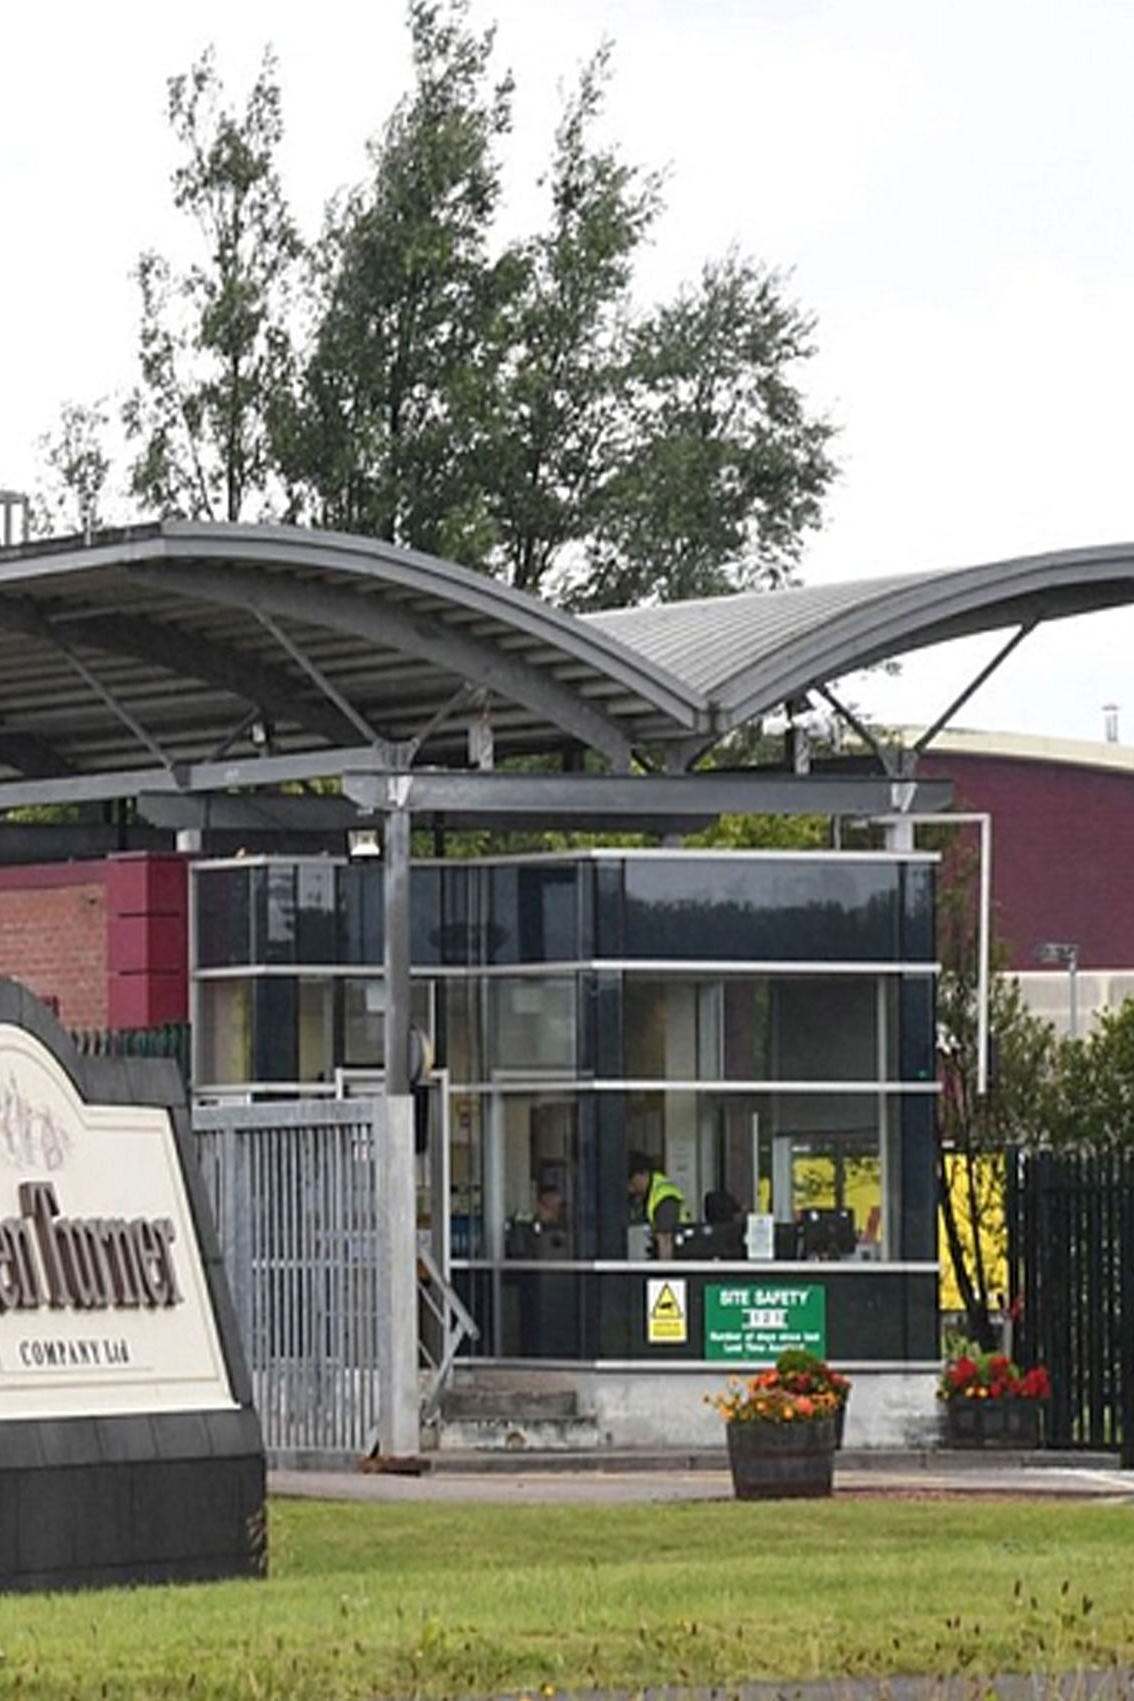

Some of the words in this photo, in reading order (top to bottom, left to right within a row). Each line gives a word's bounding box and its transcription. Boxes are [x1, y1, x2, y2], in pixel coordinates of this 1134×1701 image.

[720, 1289, 749, 1306] SITE
[754, 1289, 809, 1306] SAFETY
[19, 1339, 101, 1366] COMPANY
